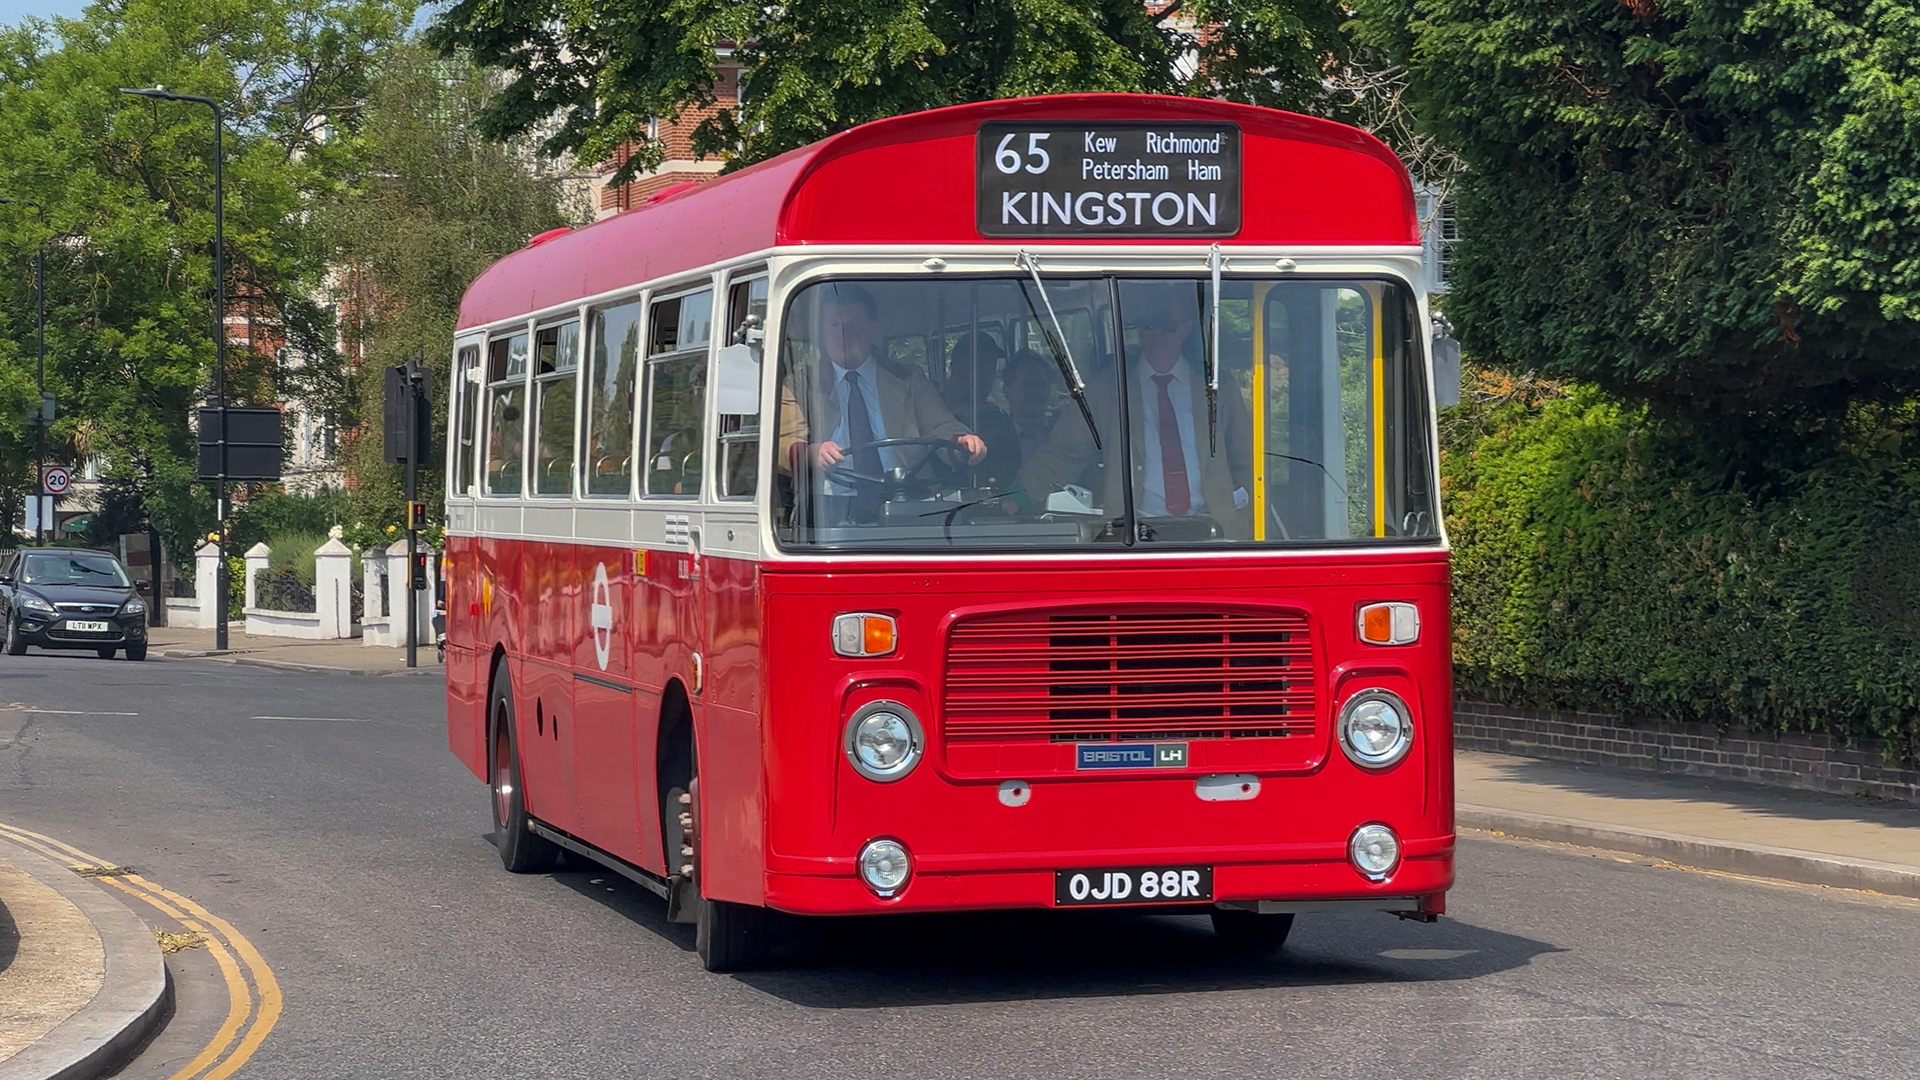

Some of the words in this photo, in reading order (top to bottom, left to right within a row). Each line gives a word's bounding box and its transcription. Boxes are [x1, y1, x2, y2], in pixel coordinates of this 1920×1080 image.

[995, 132, 1051, 174] 65
[1084, 131, 1117, 153] Kew
[1146, 131, 1220, 154] Richmond
[1082, 158, 1169, 180] Petersham
[1188, 159, 1221, 181] Ham
[1002, 191, 1216, 226] KINGSTON
[48, 475, 66, 486] 20
[1083, 750, 1151, 763] BRISTOL
[1160, 749, 1182, 761] LH
[1069, 872, 1132, 900] OJD
[1139, 870, 1200, 898] 88R
